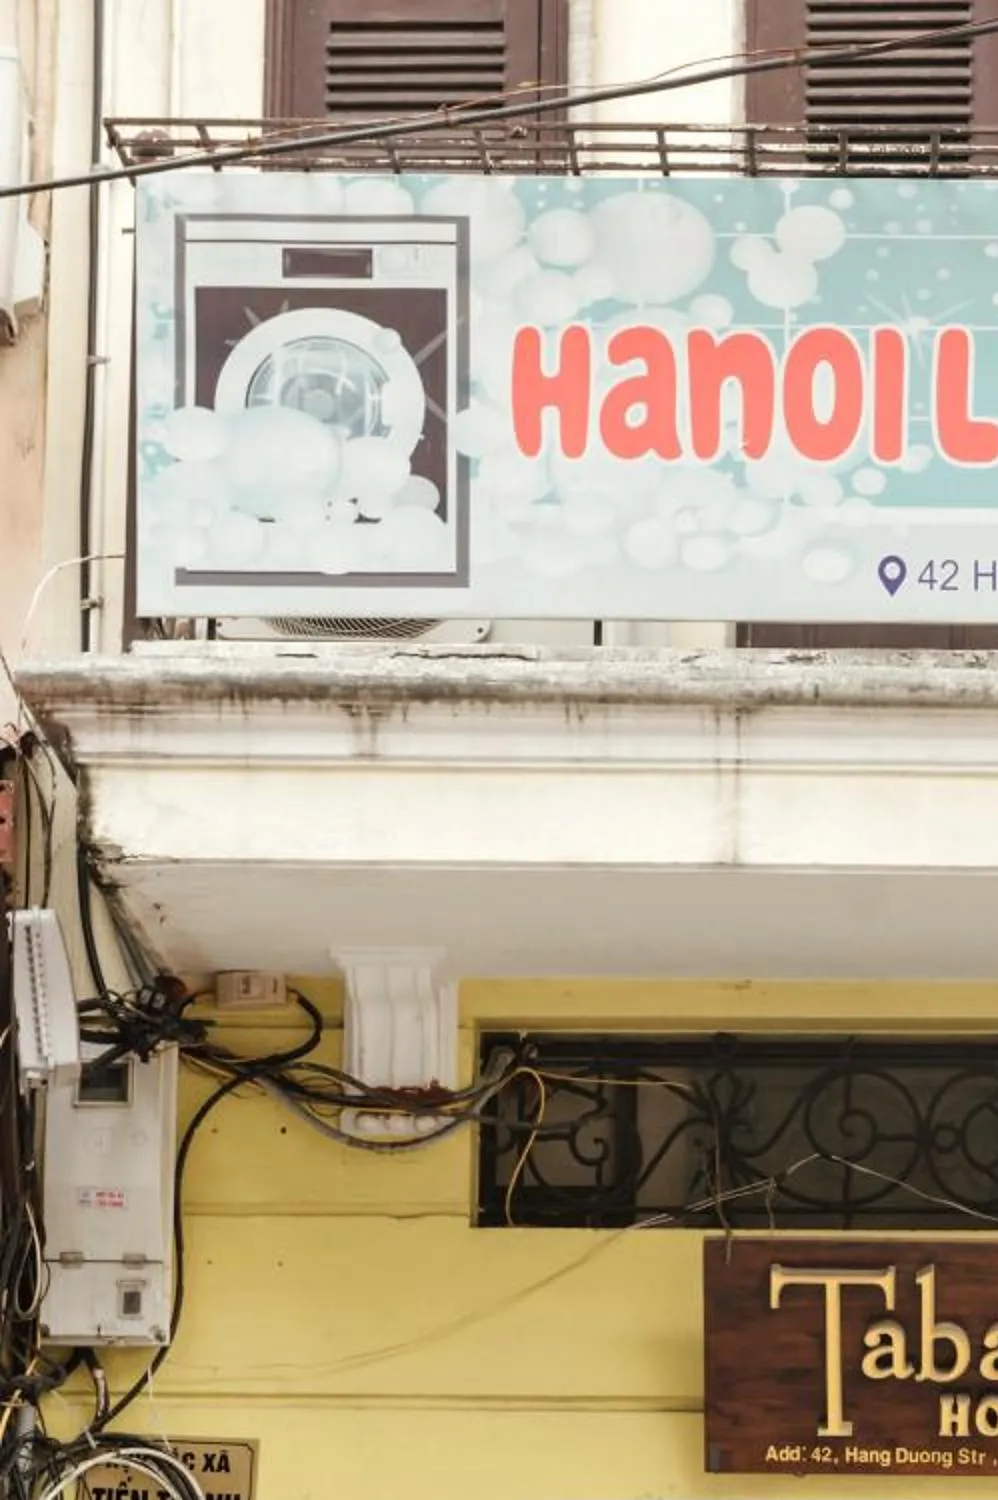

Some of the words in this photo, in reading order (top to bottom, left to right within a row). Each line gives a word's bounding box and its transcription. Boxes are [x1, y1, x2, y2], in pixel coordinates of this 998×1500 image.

[917, 560, 960, 591] 42
[846, 1447, 892, 1467] Hang
[896, 1449, 953, 1467] Duong
